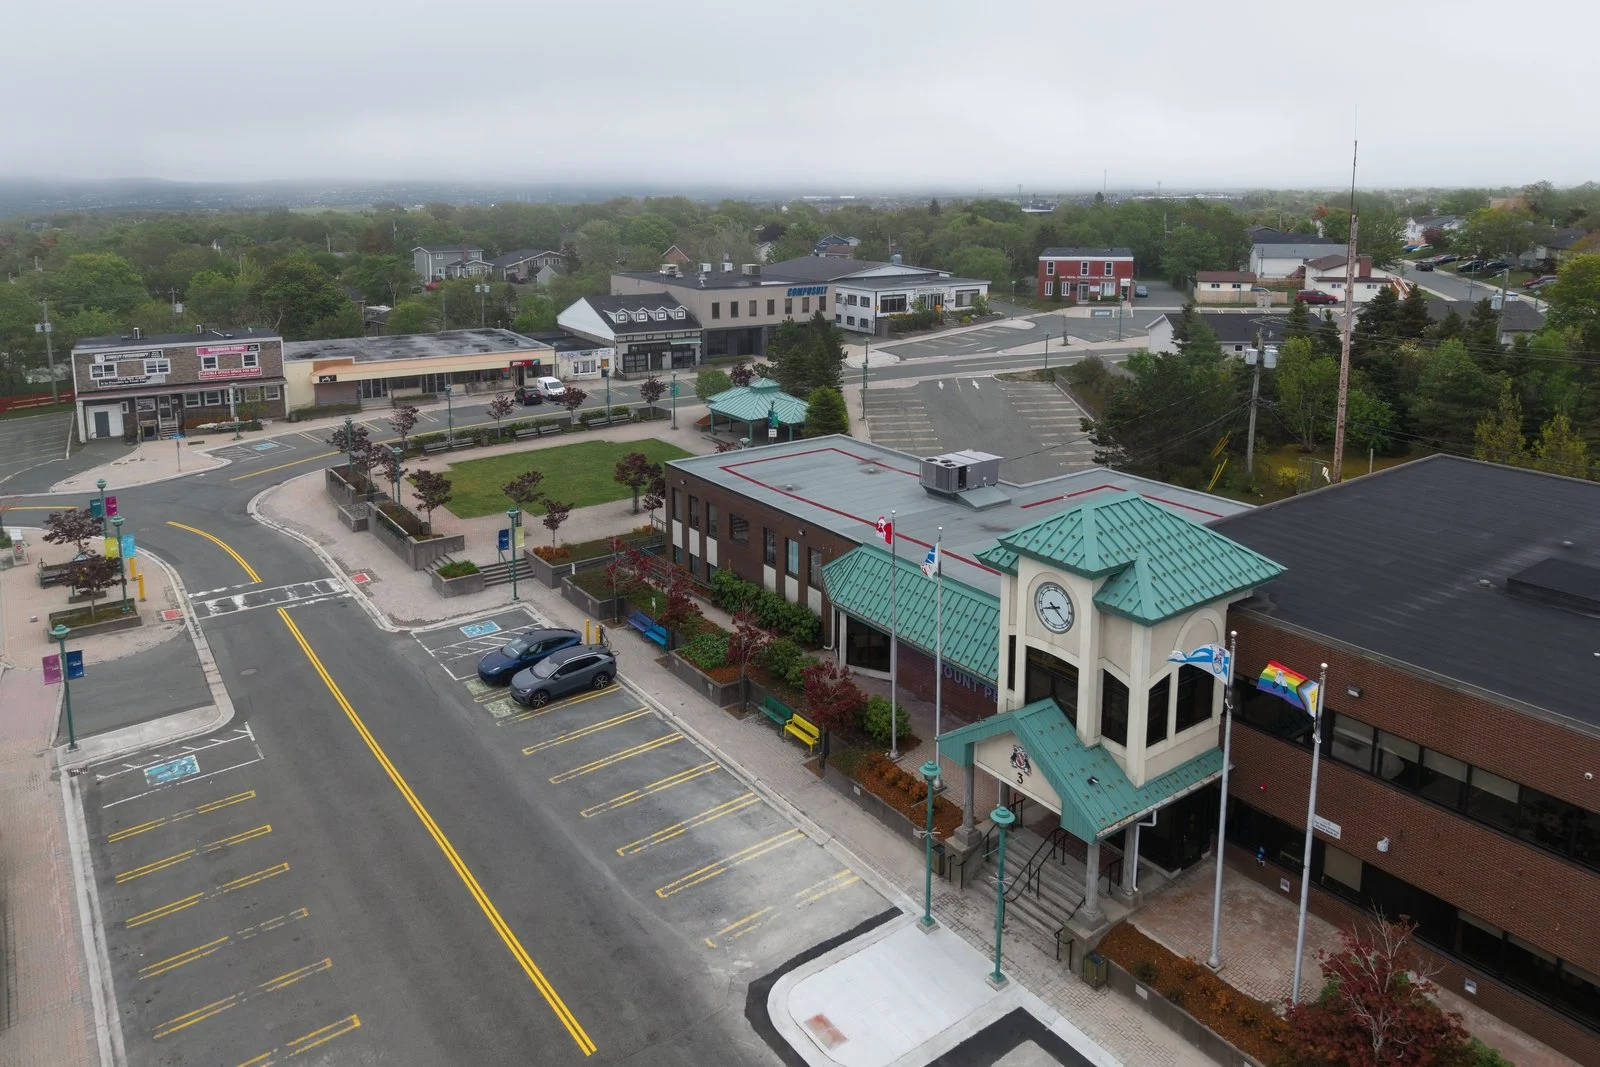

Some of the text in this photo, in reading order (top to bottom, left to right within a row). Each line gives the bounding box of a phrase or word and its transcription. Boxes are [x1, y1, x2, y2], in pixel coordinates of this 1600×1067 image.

[787, 286, 828, 297] COMPUSULT
[936, 664, 979, 692] OUNT
[1017, 772, 1024, 784] 3
